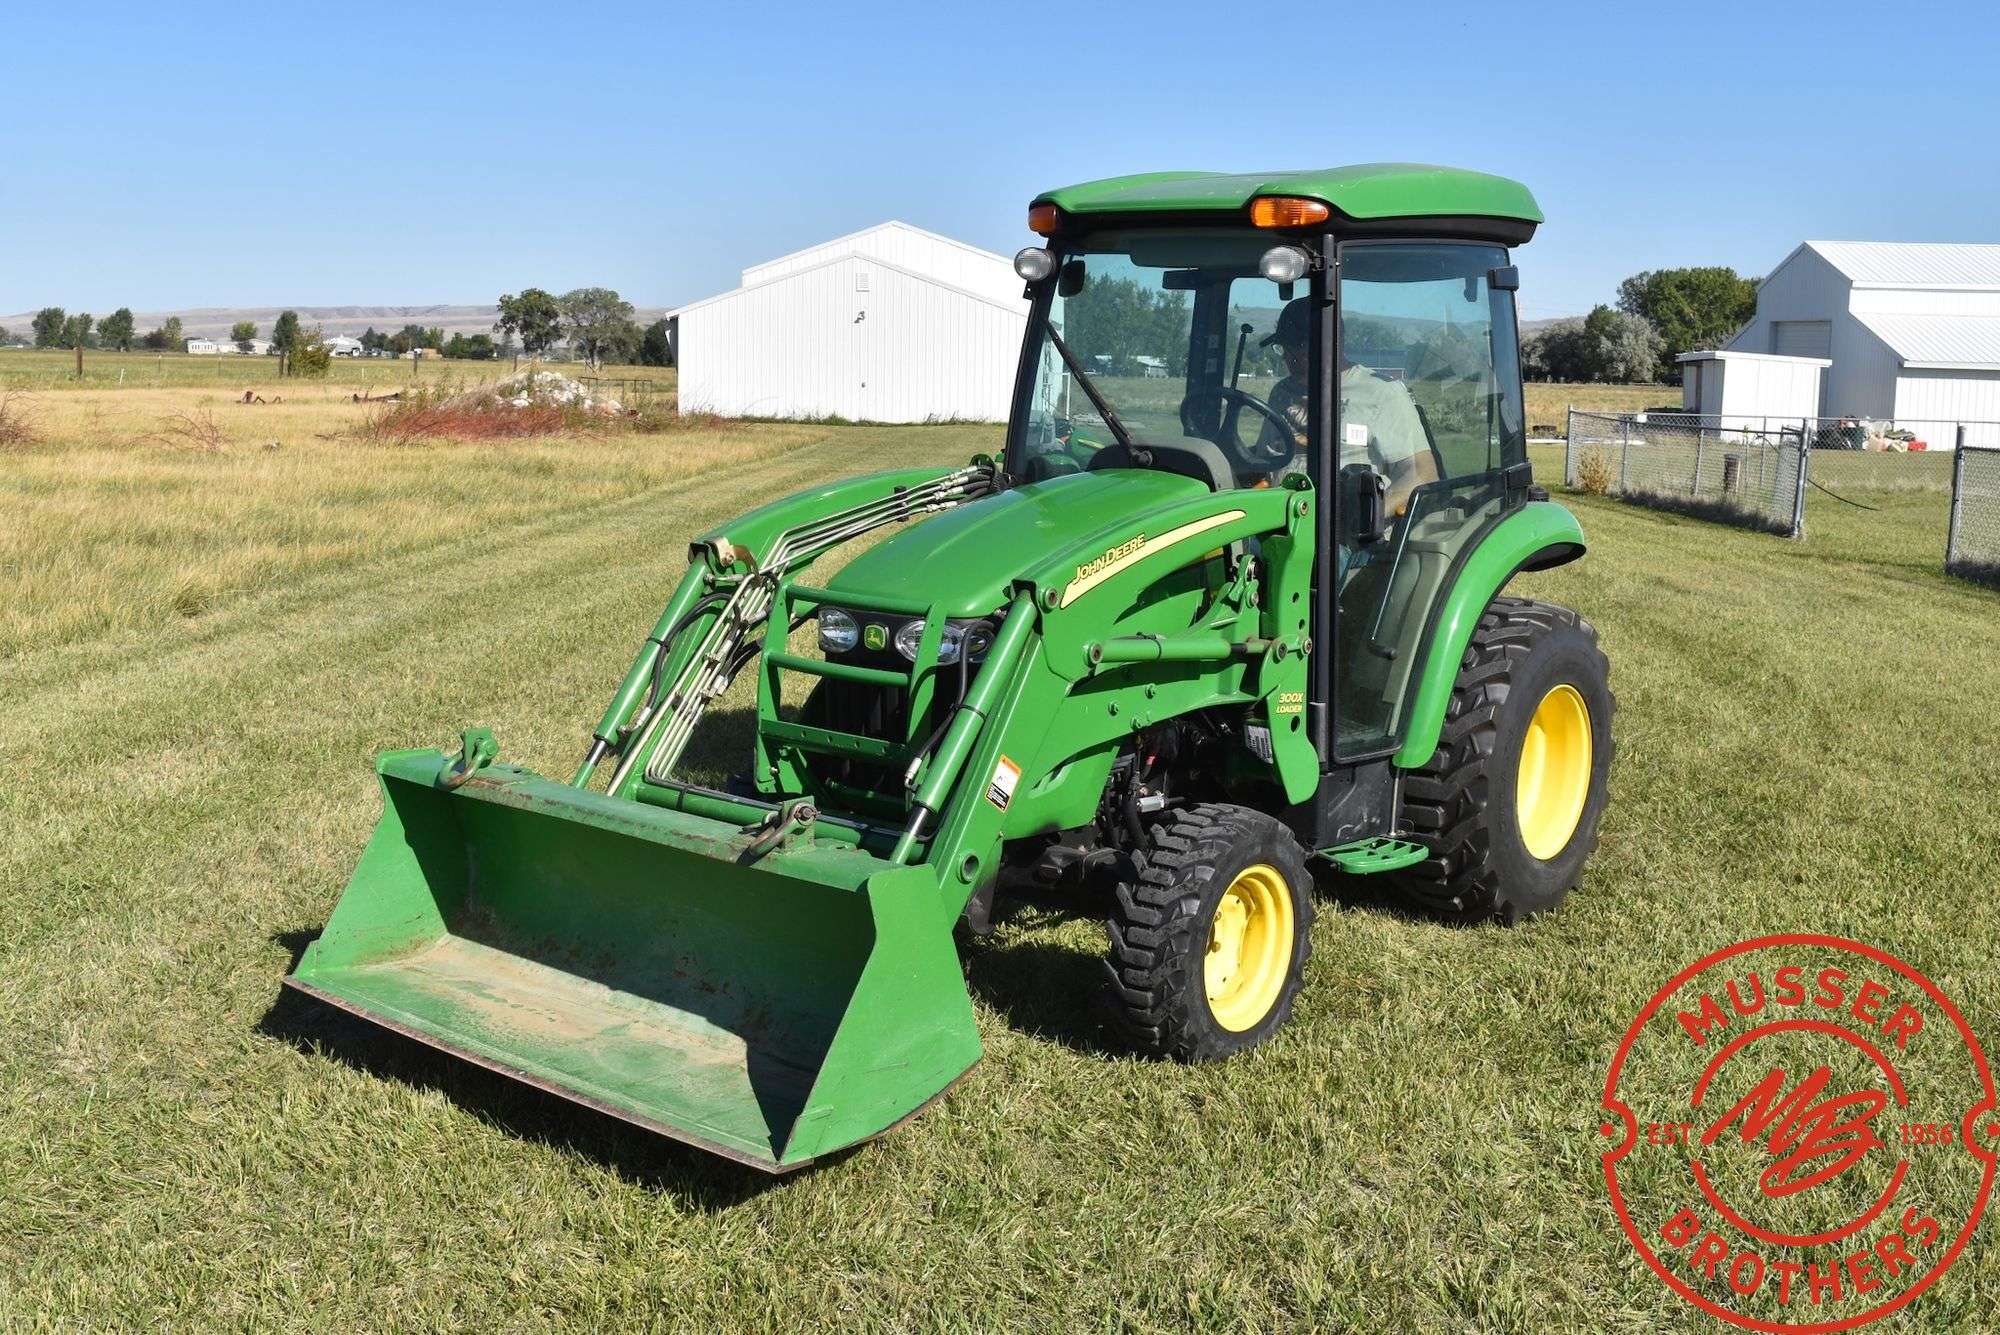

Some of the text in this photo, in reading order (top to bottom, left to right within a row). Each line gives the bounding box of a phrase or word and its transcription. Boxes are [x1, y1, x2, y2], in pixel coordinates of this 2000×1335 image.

[1073, 533, 1146, 585] JOHN DEERE
[1279, 692, 1304, 704] 300X
[1276, 704, 1303, 714] LOADER
